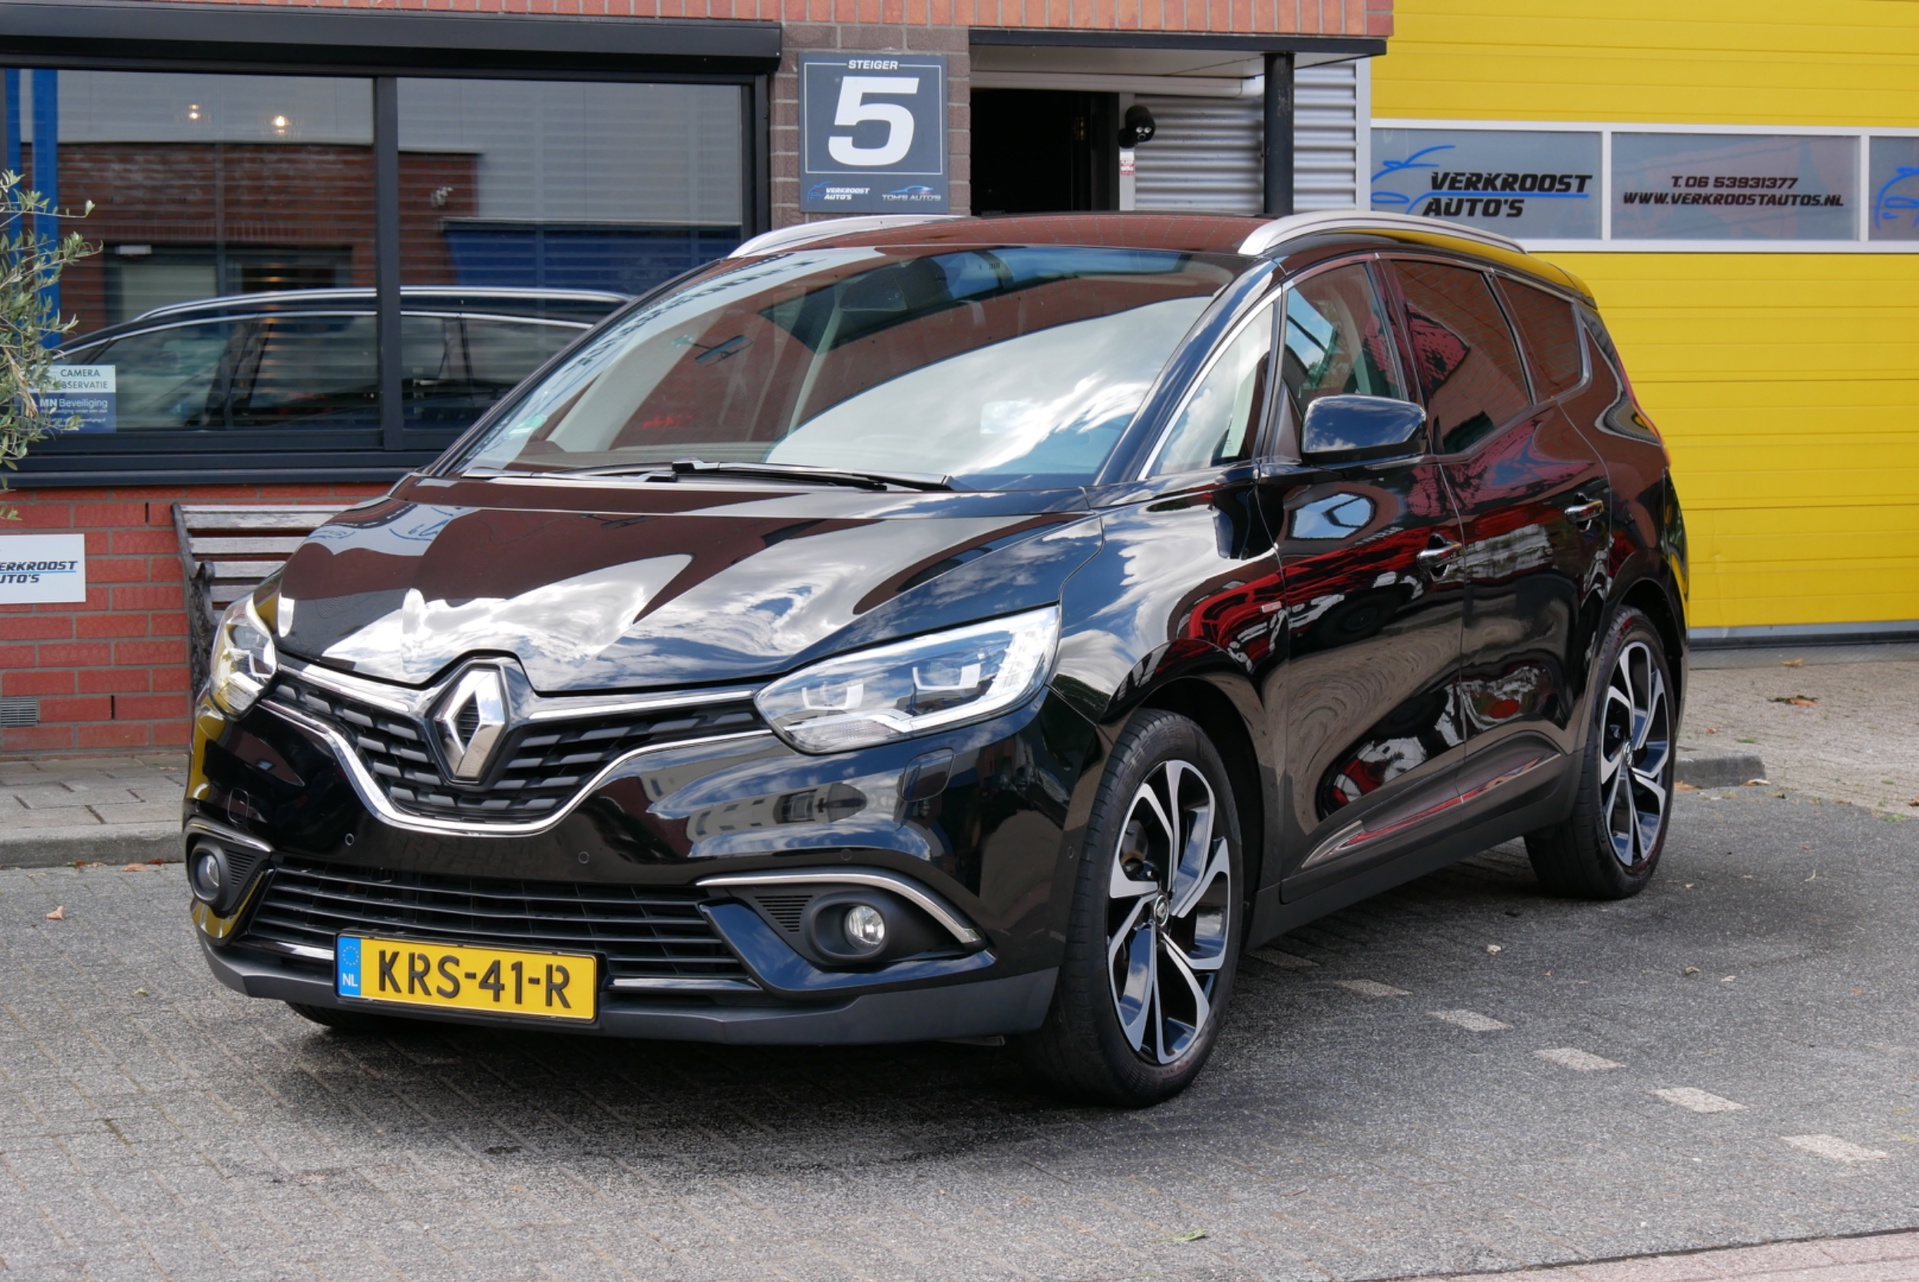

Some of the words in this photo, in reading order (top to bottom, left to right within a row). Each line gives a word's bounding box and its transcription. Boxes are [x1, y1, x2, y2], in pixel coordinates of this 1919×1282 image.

[848, 60, 898, 70] STEIGER
[828, 76, 919, 166] 5
[1431, 171, 1593, 193] VERKROOST
[1671, 176, 1681, 188] T.
[1685, 176, 1709, 188] 06
[1713, 176, 1798, 189] 53931377
[1623, 191, 1844, 207] WWW.VERKROOSTAUTOS.NL
[1422, 197, 1525, 217] AUTO'S
[60, 369, 100, 377] CAMERA
[61, 381, 108, 389] BSERVATIE
[40, 399, 57, 407] MN
[59, 398, 108, 410] Beveiliging
[0, 561, 78, 571] ERKROOST
[0, 574, 40, 584] UTO'S
[342, 972, 358, 987] NL
[378, 950, 571, 1009] KRS-41-R
